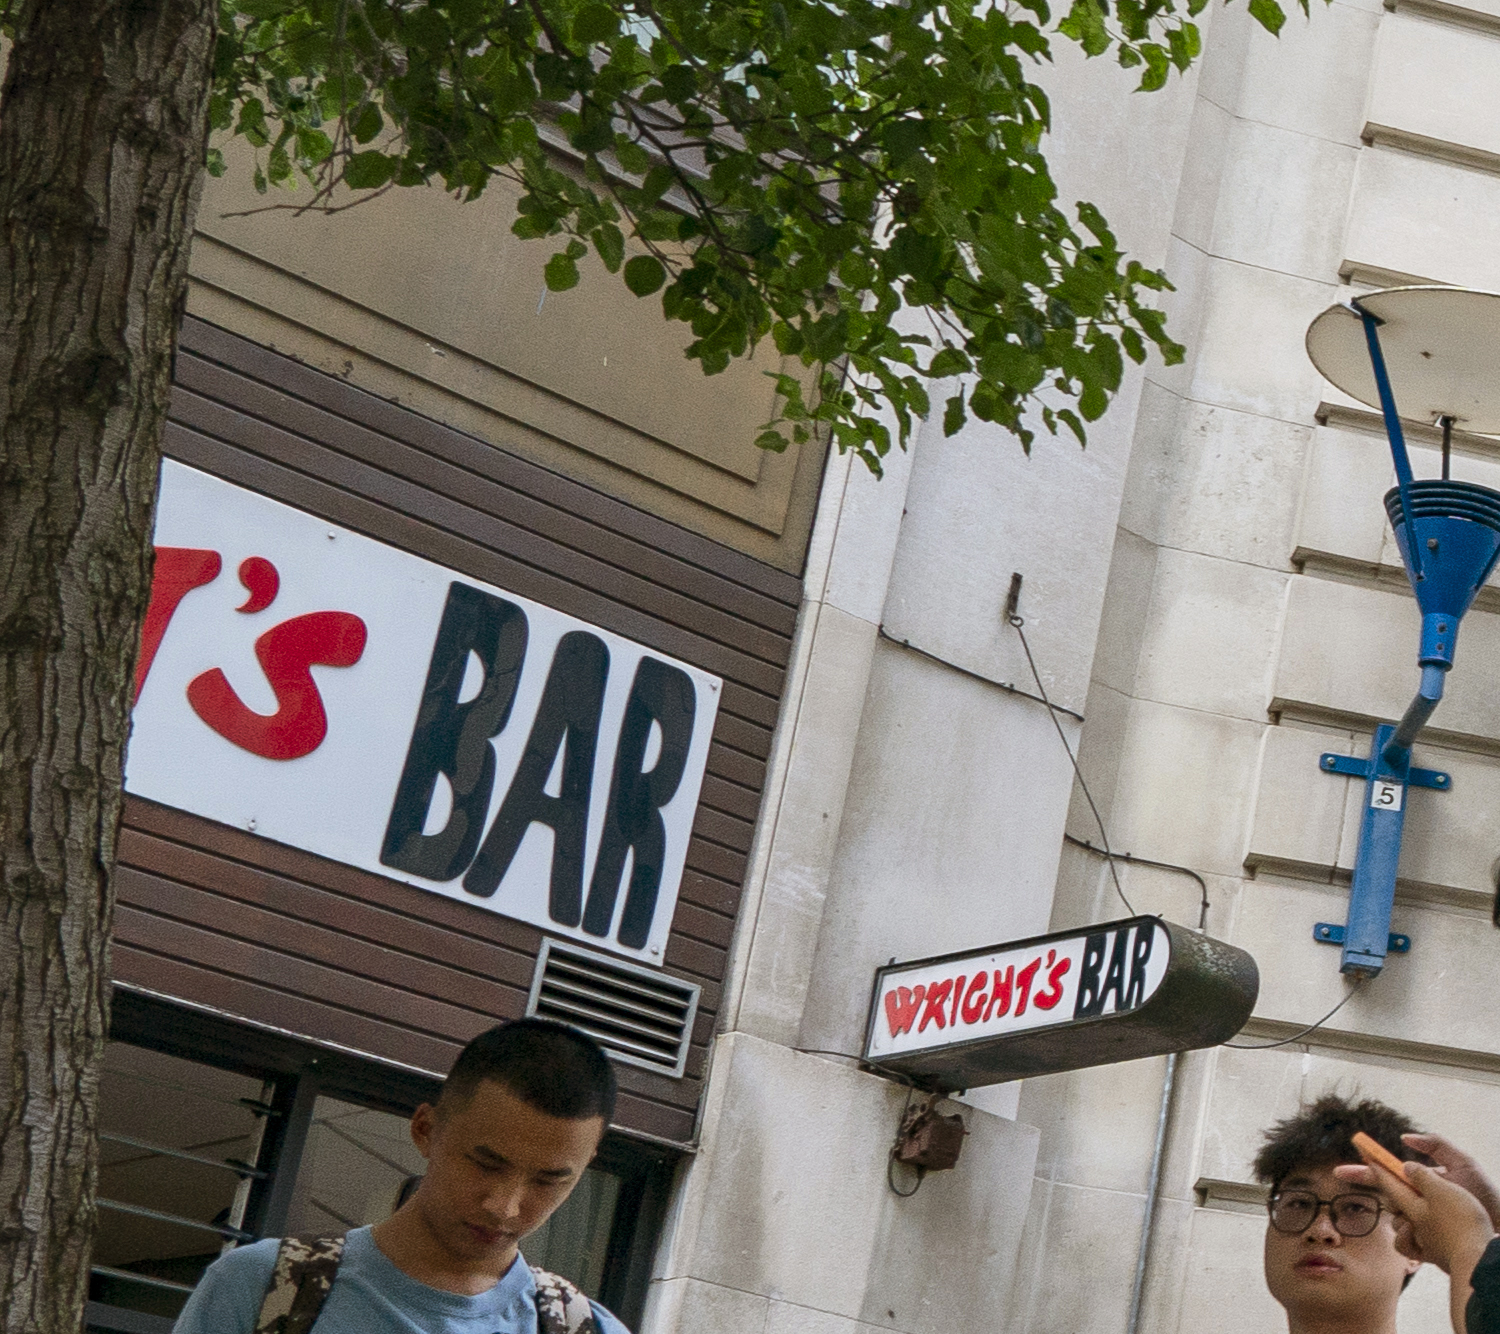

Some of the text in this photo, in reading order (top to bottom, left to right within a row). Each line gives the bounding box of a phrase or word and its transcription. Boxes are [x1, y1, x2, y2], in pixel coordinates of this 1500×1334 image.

[380, 581, 696, 949] BAR
[1376, 787, 1394, 805] 5
[884, 924, 1155, 1038] WRIGHT'S BAR
